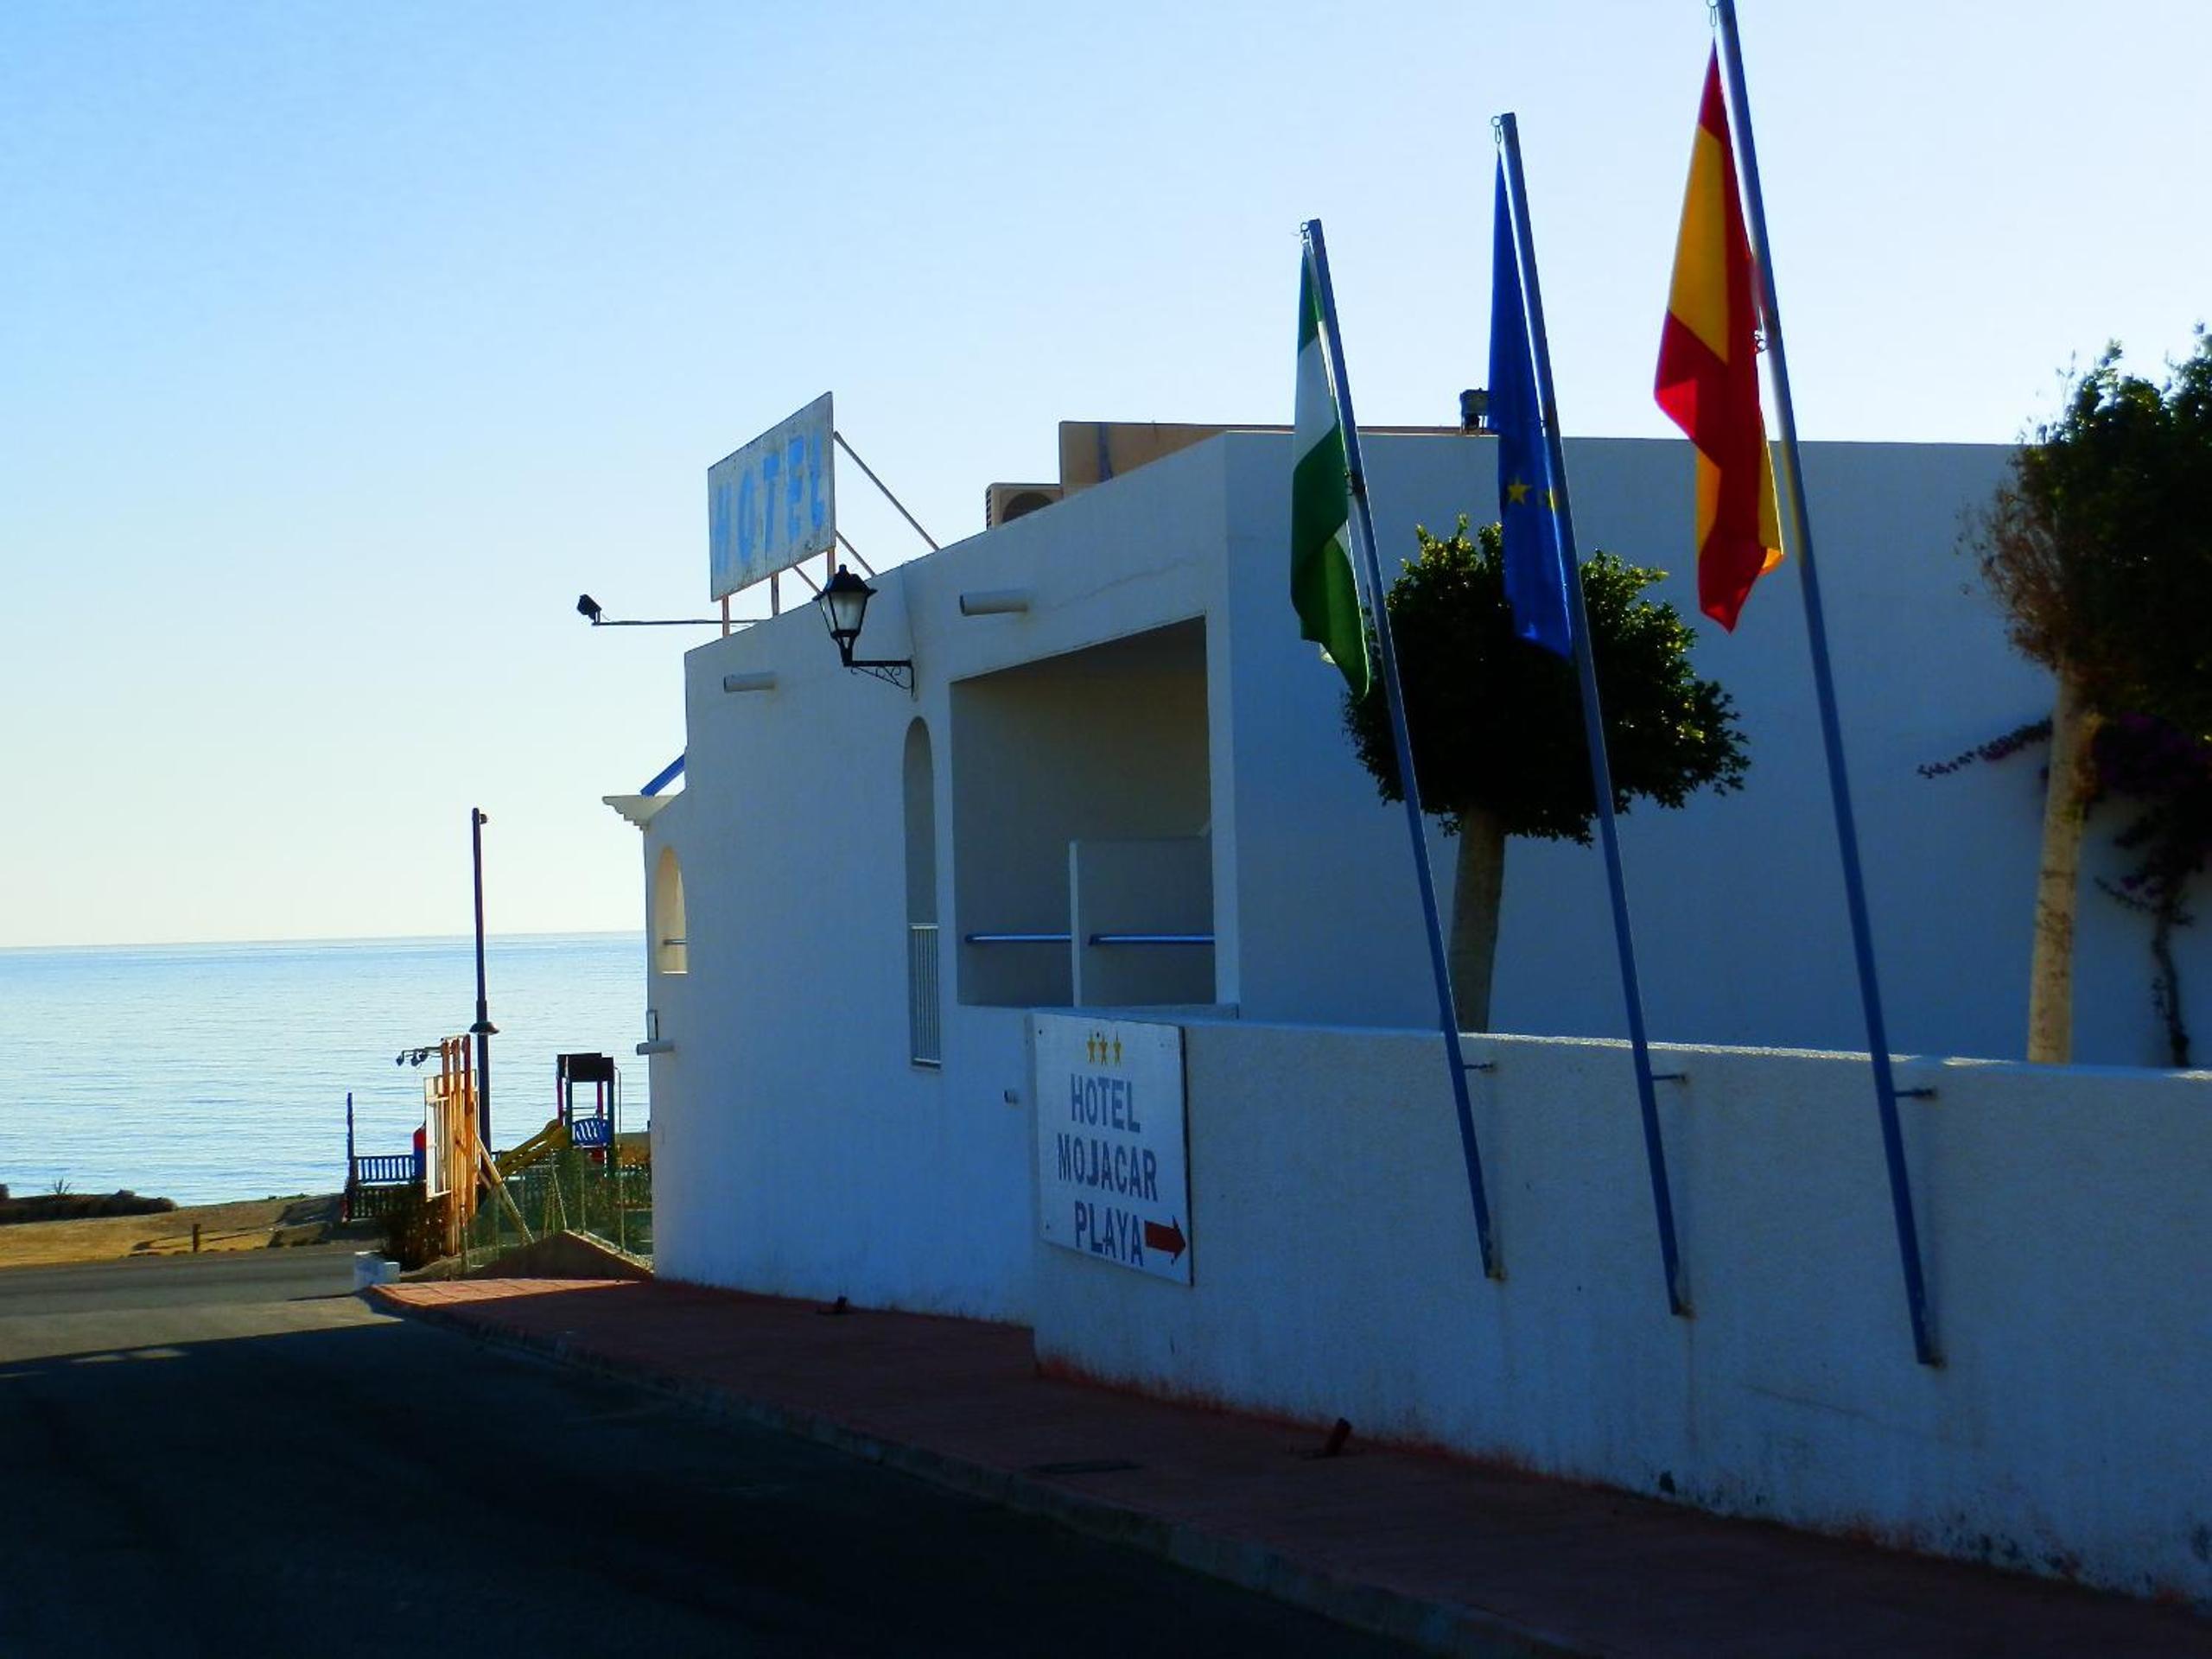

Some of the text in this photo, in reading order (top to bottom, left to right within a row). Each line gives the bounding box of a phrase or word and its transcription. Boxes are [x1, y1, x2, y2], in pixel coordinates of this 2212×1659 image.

[715, 430, 825, 574] HOTEL
[1071, 1073, 1141, 1133] HOTEL
[1058, 1133, 1158, 1201] MOJACAR
[1075, 1201, 1143, 1266] PLAYA
